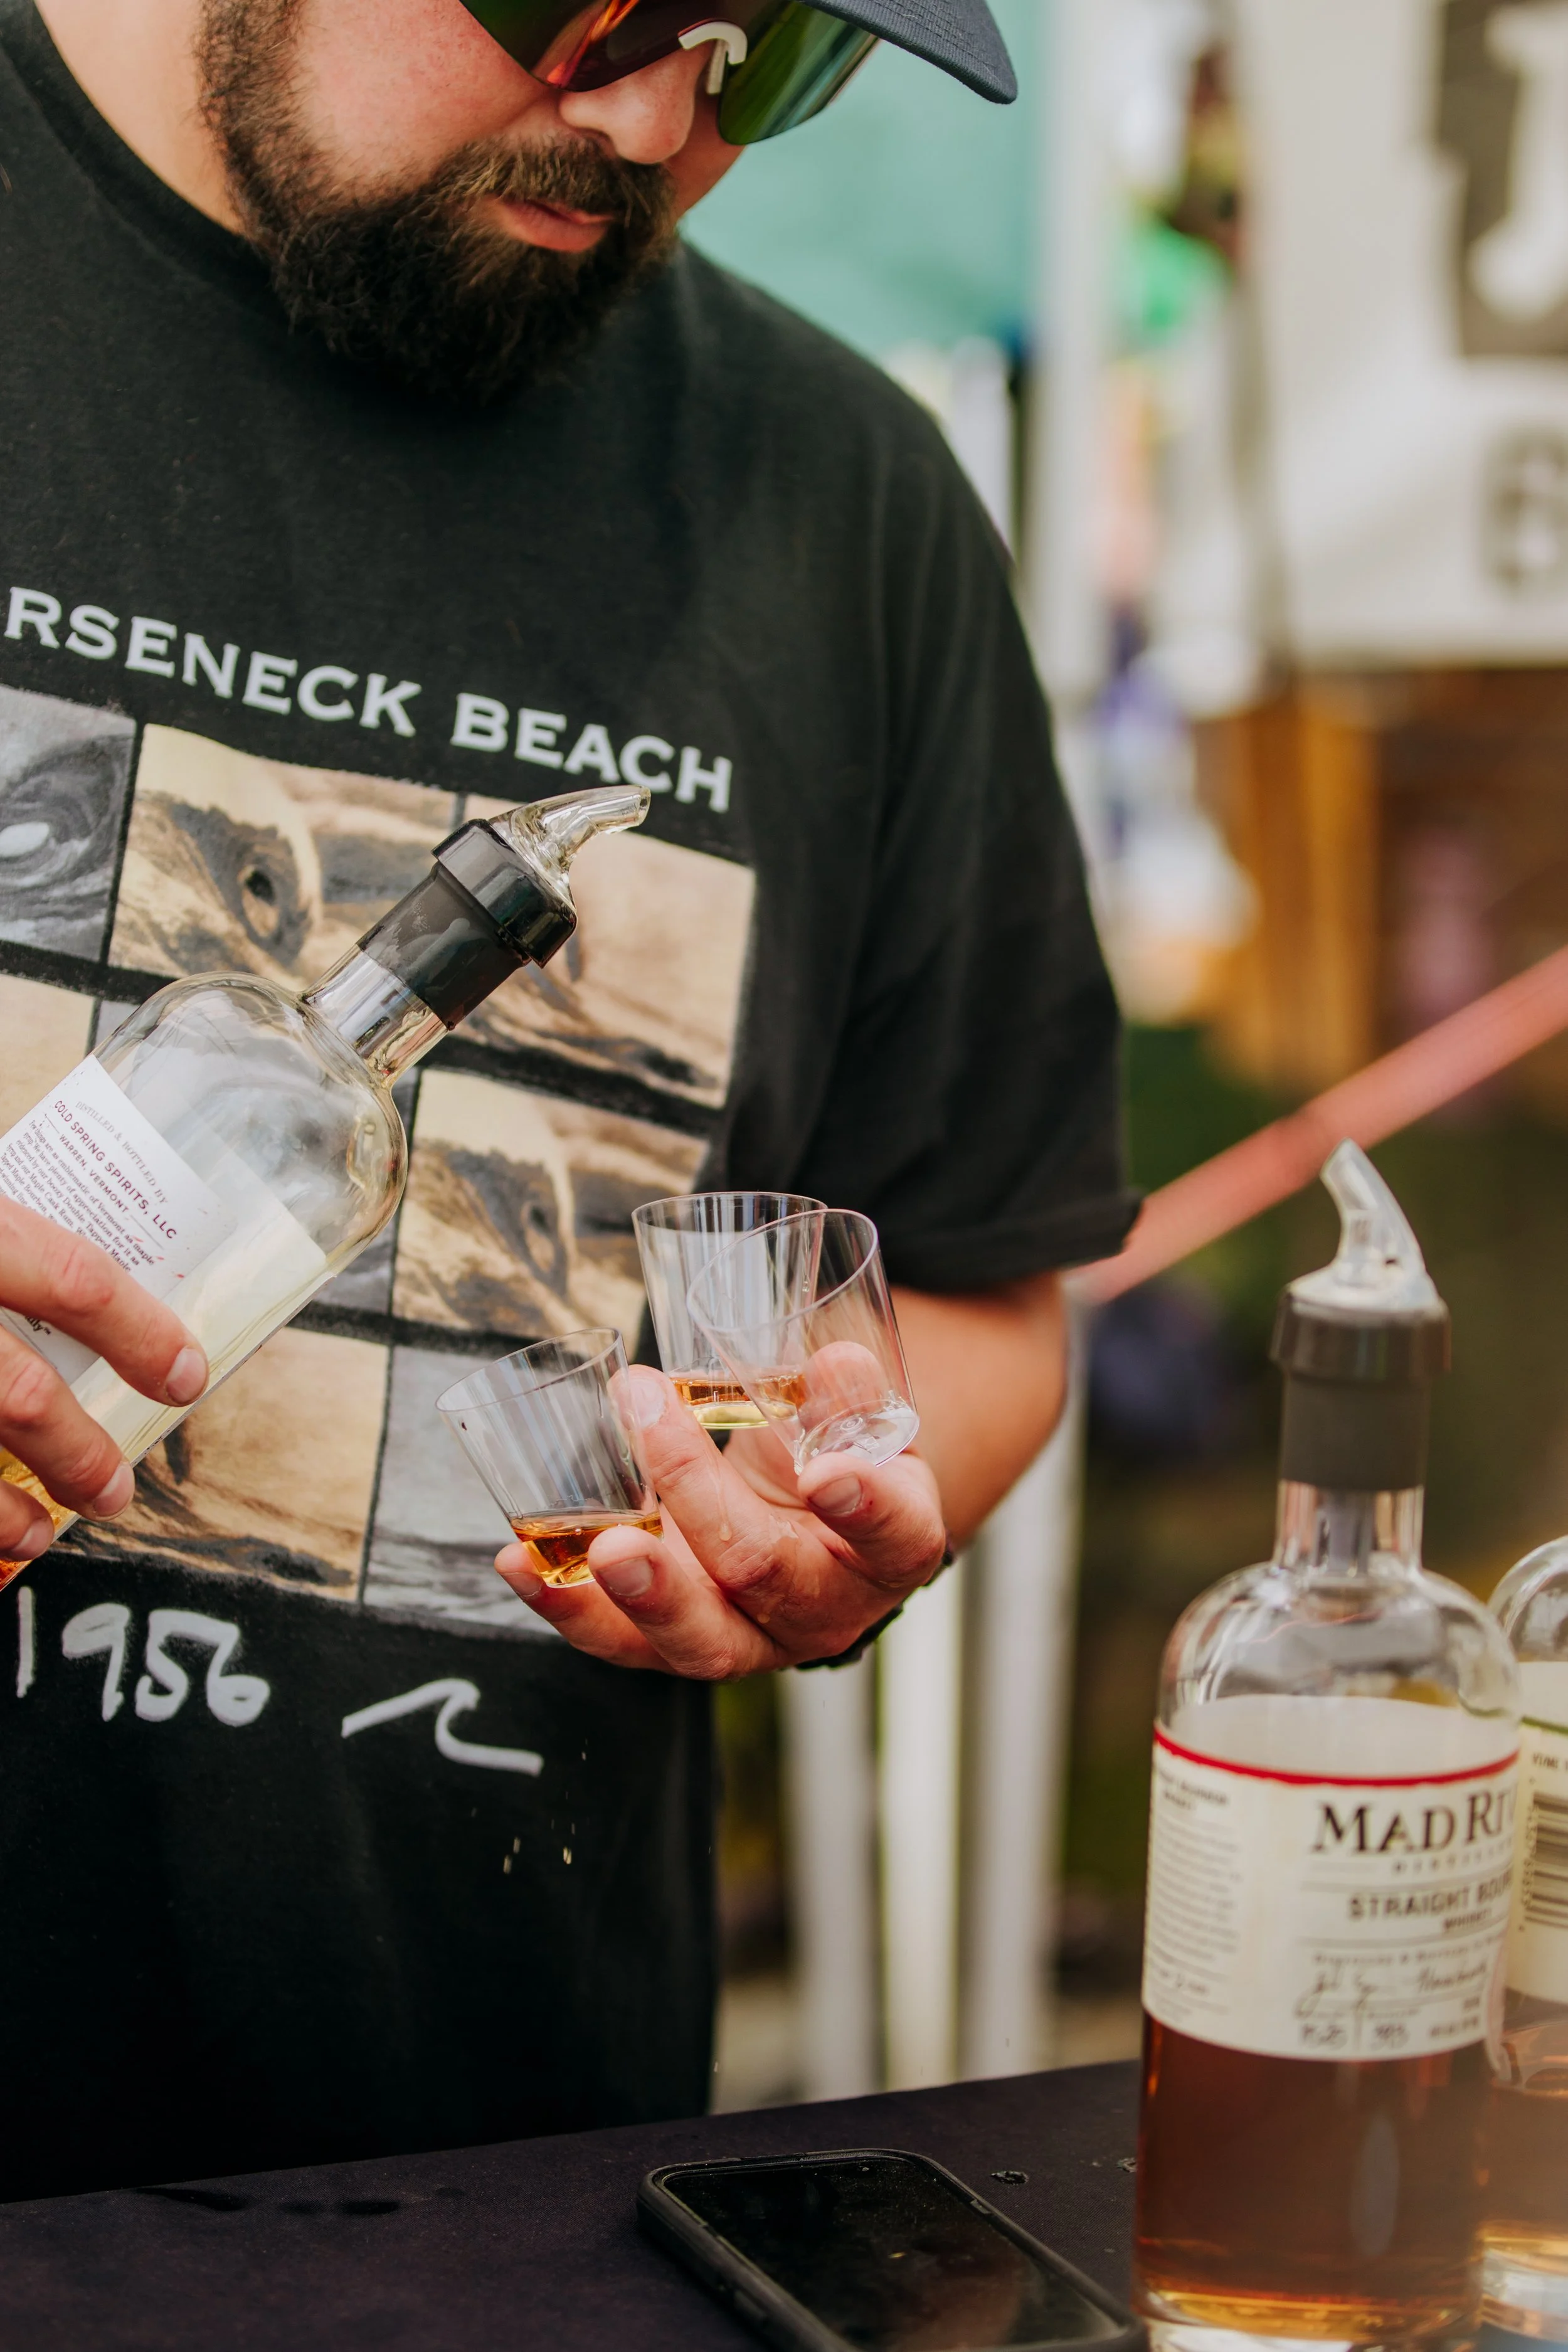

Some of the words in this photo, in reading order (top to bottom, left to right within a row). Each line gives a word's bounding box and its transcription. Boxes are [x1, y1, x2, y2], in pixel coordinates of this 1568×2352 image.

[5, 586, 423, 737] RSENECK
[450, 692, 733, 813] BEACH
[11, 1167, 26, 1185] Maple
[16, 1139, 35, 1162] evidenced
[31, 1158, 39, 1169] by
[38, 1168, 48, 1179] our
[46, 1177, 64, 1199] boozy
[62, 1195, 85, 1224] Double
[85, 1221, 111, 1251] Tapped
[21, 1164, 31, 1175] our
[29, 1172, 45, 1192] Maple
[44, 1191, 60, 1210] Cask
[39, 1150, 51, 1165] have
[48, 1165, 68, 1187] plenty
[66, 1185, 76, 1194] of
[72, 1194, 113, 1237] appreciation
[112, 1236, 124, 1248] for
[124, 1247, 131, 1257] it
[130, 1256, 139, 1266] as
[45, 1142, 53, 1152] are
[51, 1152, 60, 1160] as
[58, 1159, 90, 1194] emblematic
[89, 1195, 100, 1204] of
[97, 1202, 125, 1235] Vermont
[124, 1234, 134, 1244] as
[133, 1243, 154, 1266] maple
[55, 1100, 73, 1122] COLD
[70, 1121, 105, 1162] SPRING
[105, 1162, 149, 1216] SPIRITS,
[152, 1214, 177, 1240] LLC
[60, 1133, 88, 1171] WARREN,
[89, 1168, 129, 1213] VERMONT
[75, 1101, 115, 1133] DISTILLED
[114, 1131, 123, 1142] &
[122, 1141, 156, 1187] BOTTLED
[154, 1189, 168, 1204] BY
[16, 1586, 271, 1727] 1956
[1348, 1884, 1470, 1920] STRAIGHT
